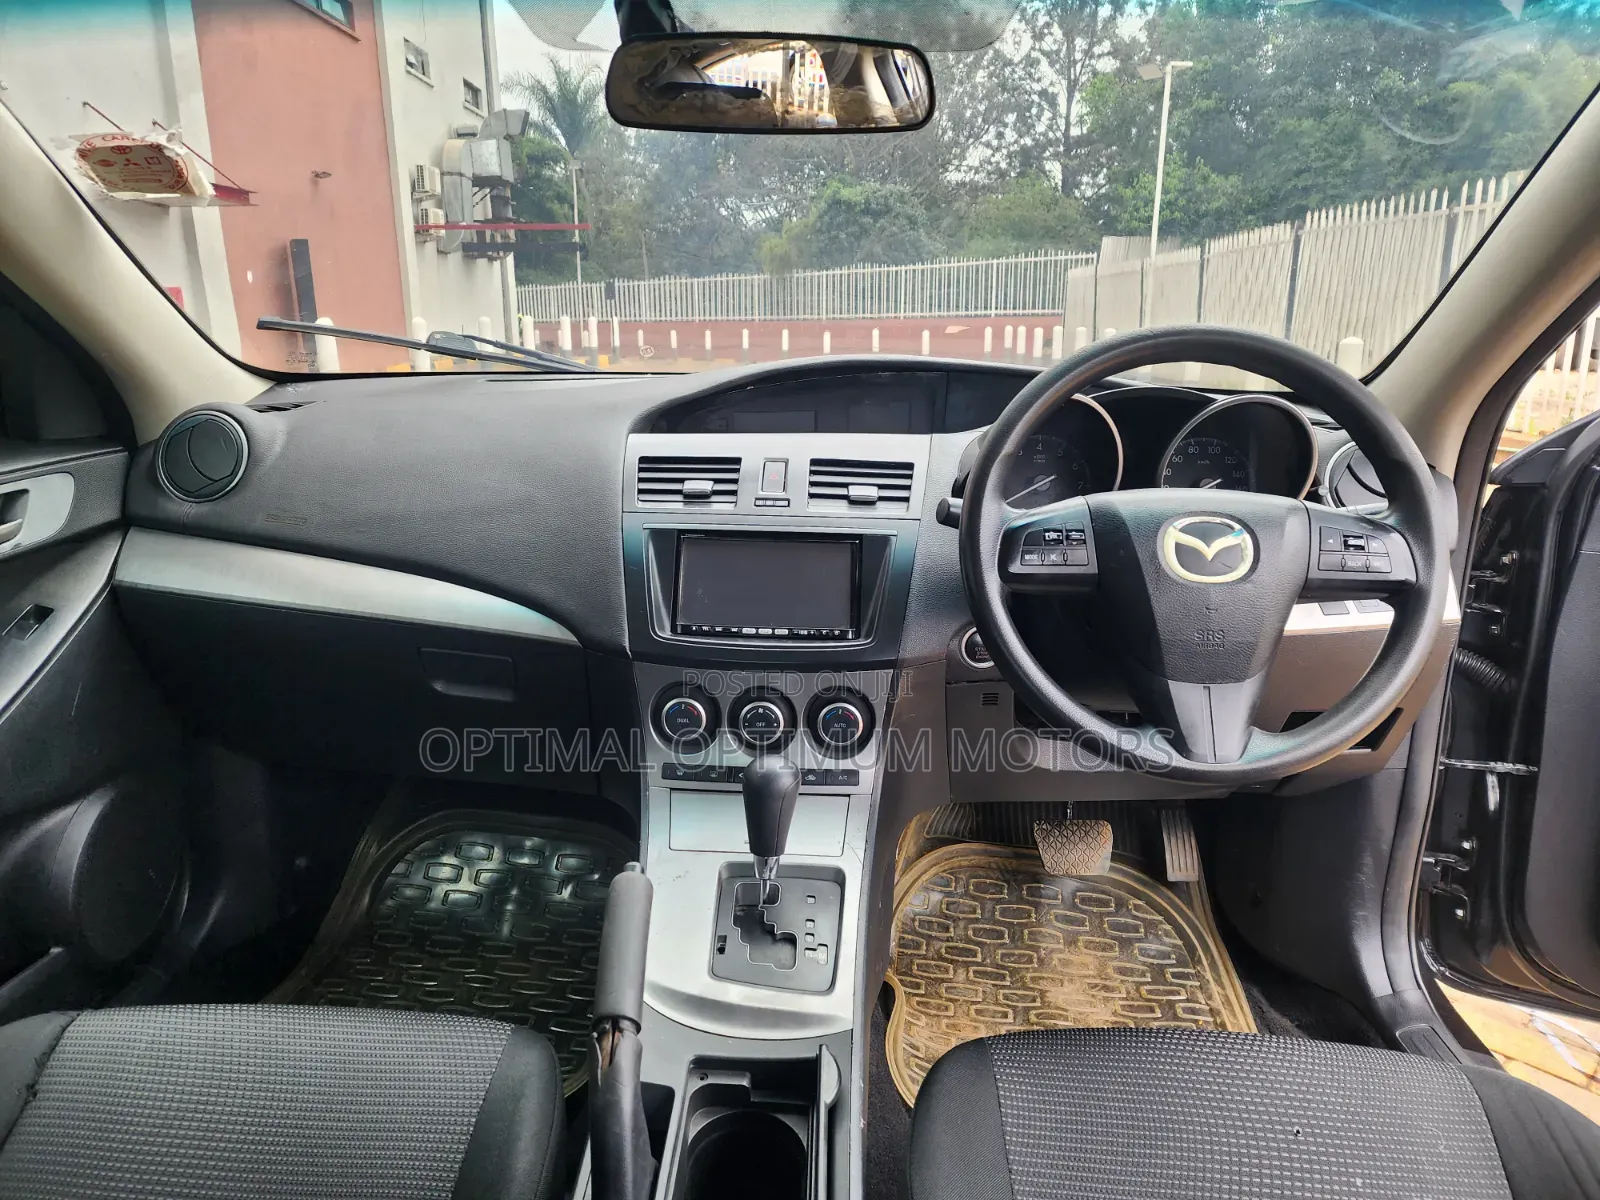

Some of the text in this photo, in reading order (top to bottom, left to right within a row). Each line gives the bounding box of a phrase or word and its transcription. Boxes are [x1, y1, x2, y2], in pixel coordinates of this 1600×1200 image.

[1057, 448, 1063, 456] 5
[1208, 446, 1220, 454] 100
[1172, 455, 1183, 463] 60
[1225, 456, 1237, 464] 120
[1072, 461, 1078, 470] 6
[1233, 470, 1245, 478] 140
[1078, 481, 1083, 489] 7
[1194, 629, 1226, 641] SRS
